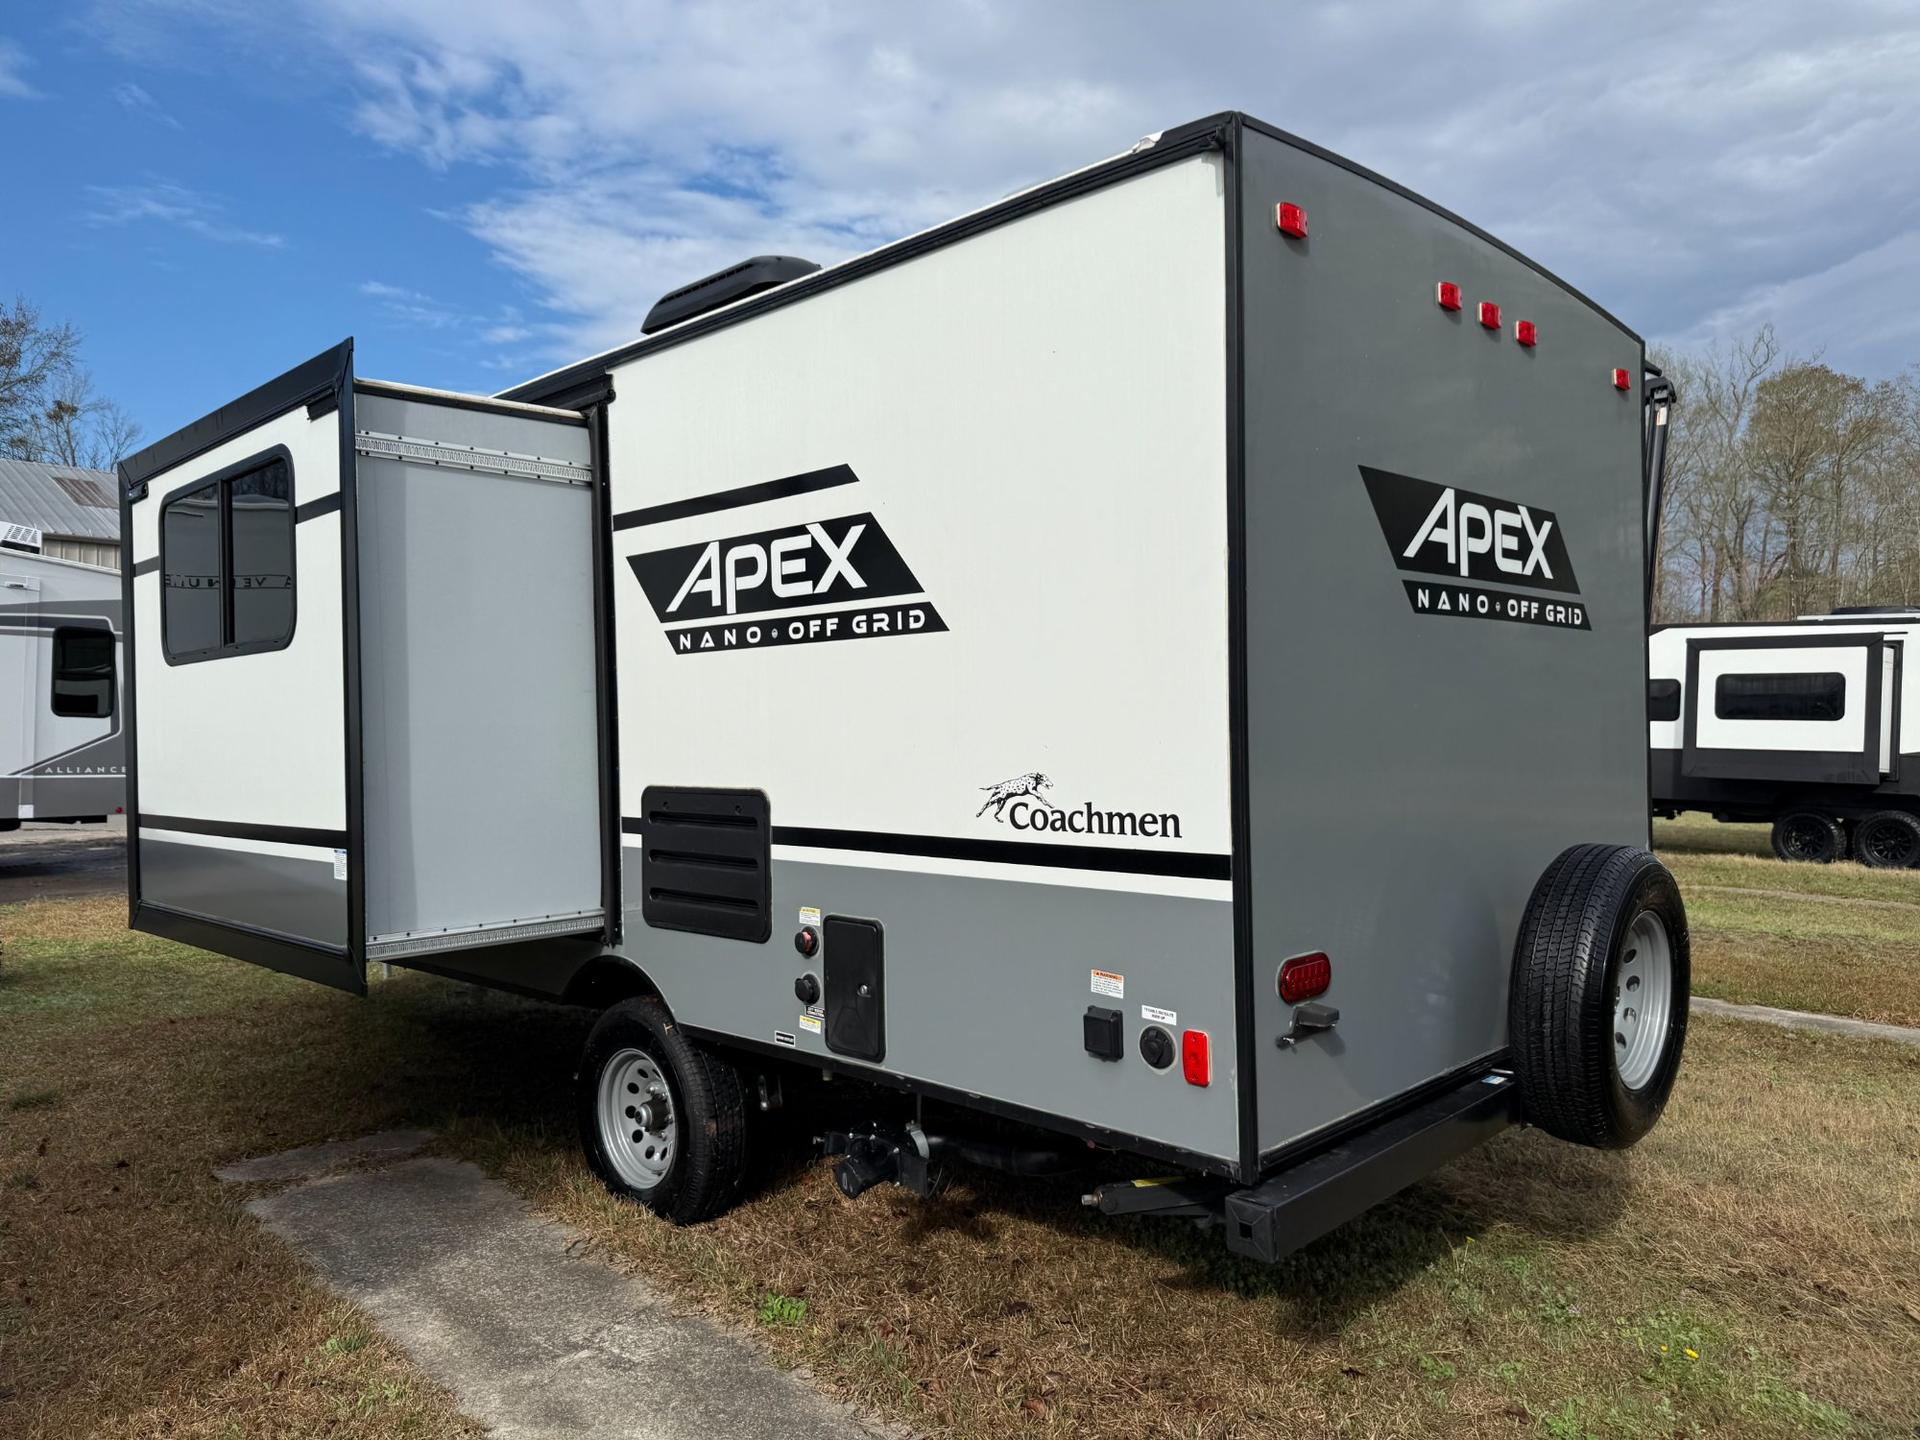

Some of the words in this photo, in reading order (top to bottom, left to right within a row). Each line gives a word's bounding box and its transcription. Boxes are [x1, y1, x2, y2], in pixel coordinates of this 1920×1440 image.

[1402, 487, 1554, 579] APEX
[665, 522, 868, 615] APEX
[1418, 588, 1489, 614] NANO
[1507, 599, 1539, 620] OFF
[1545, 604, 1583, 625] GRID
[679, 625, 762, 651] NANO
[788, 616, 840, 640] OFF
[851, 609, 926, 634] GRID
[44, 766, 127, 774] ALLIANCE
[1009, 801, 1183, 838] Coachmen
